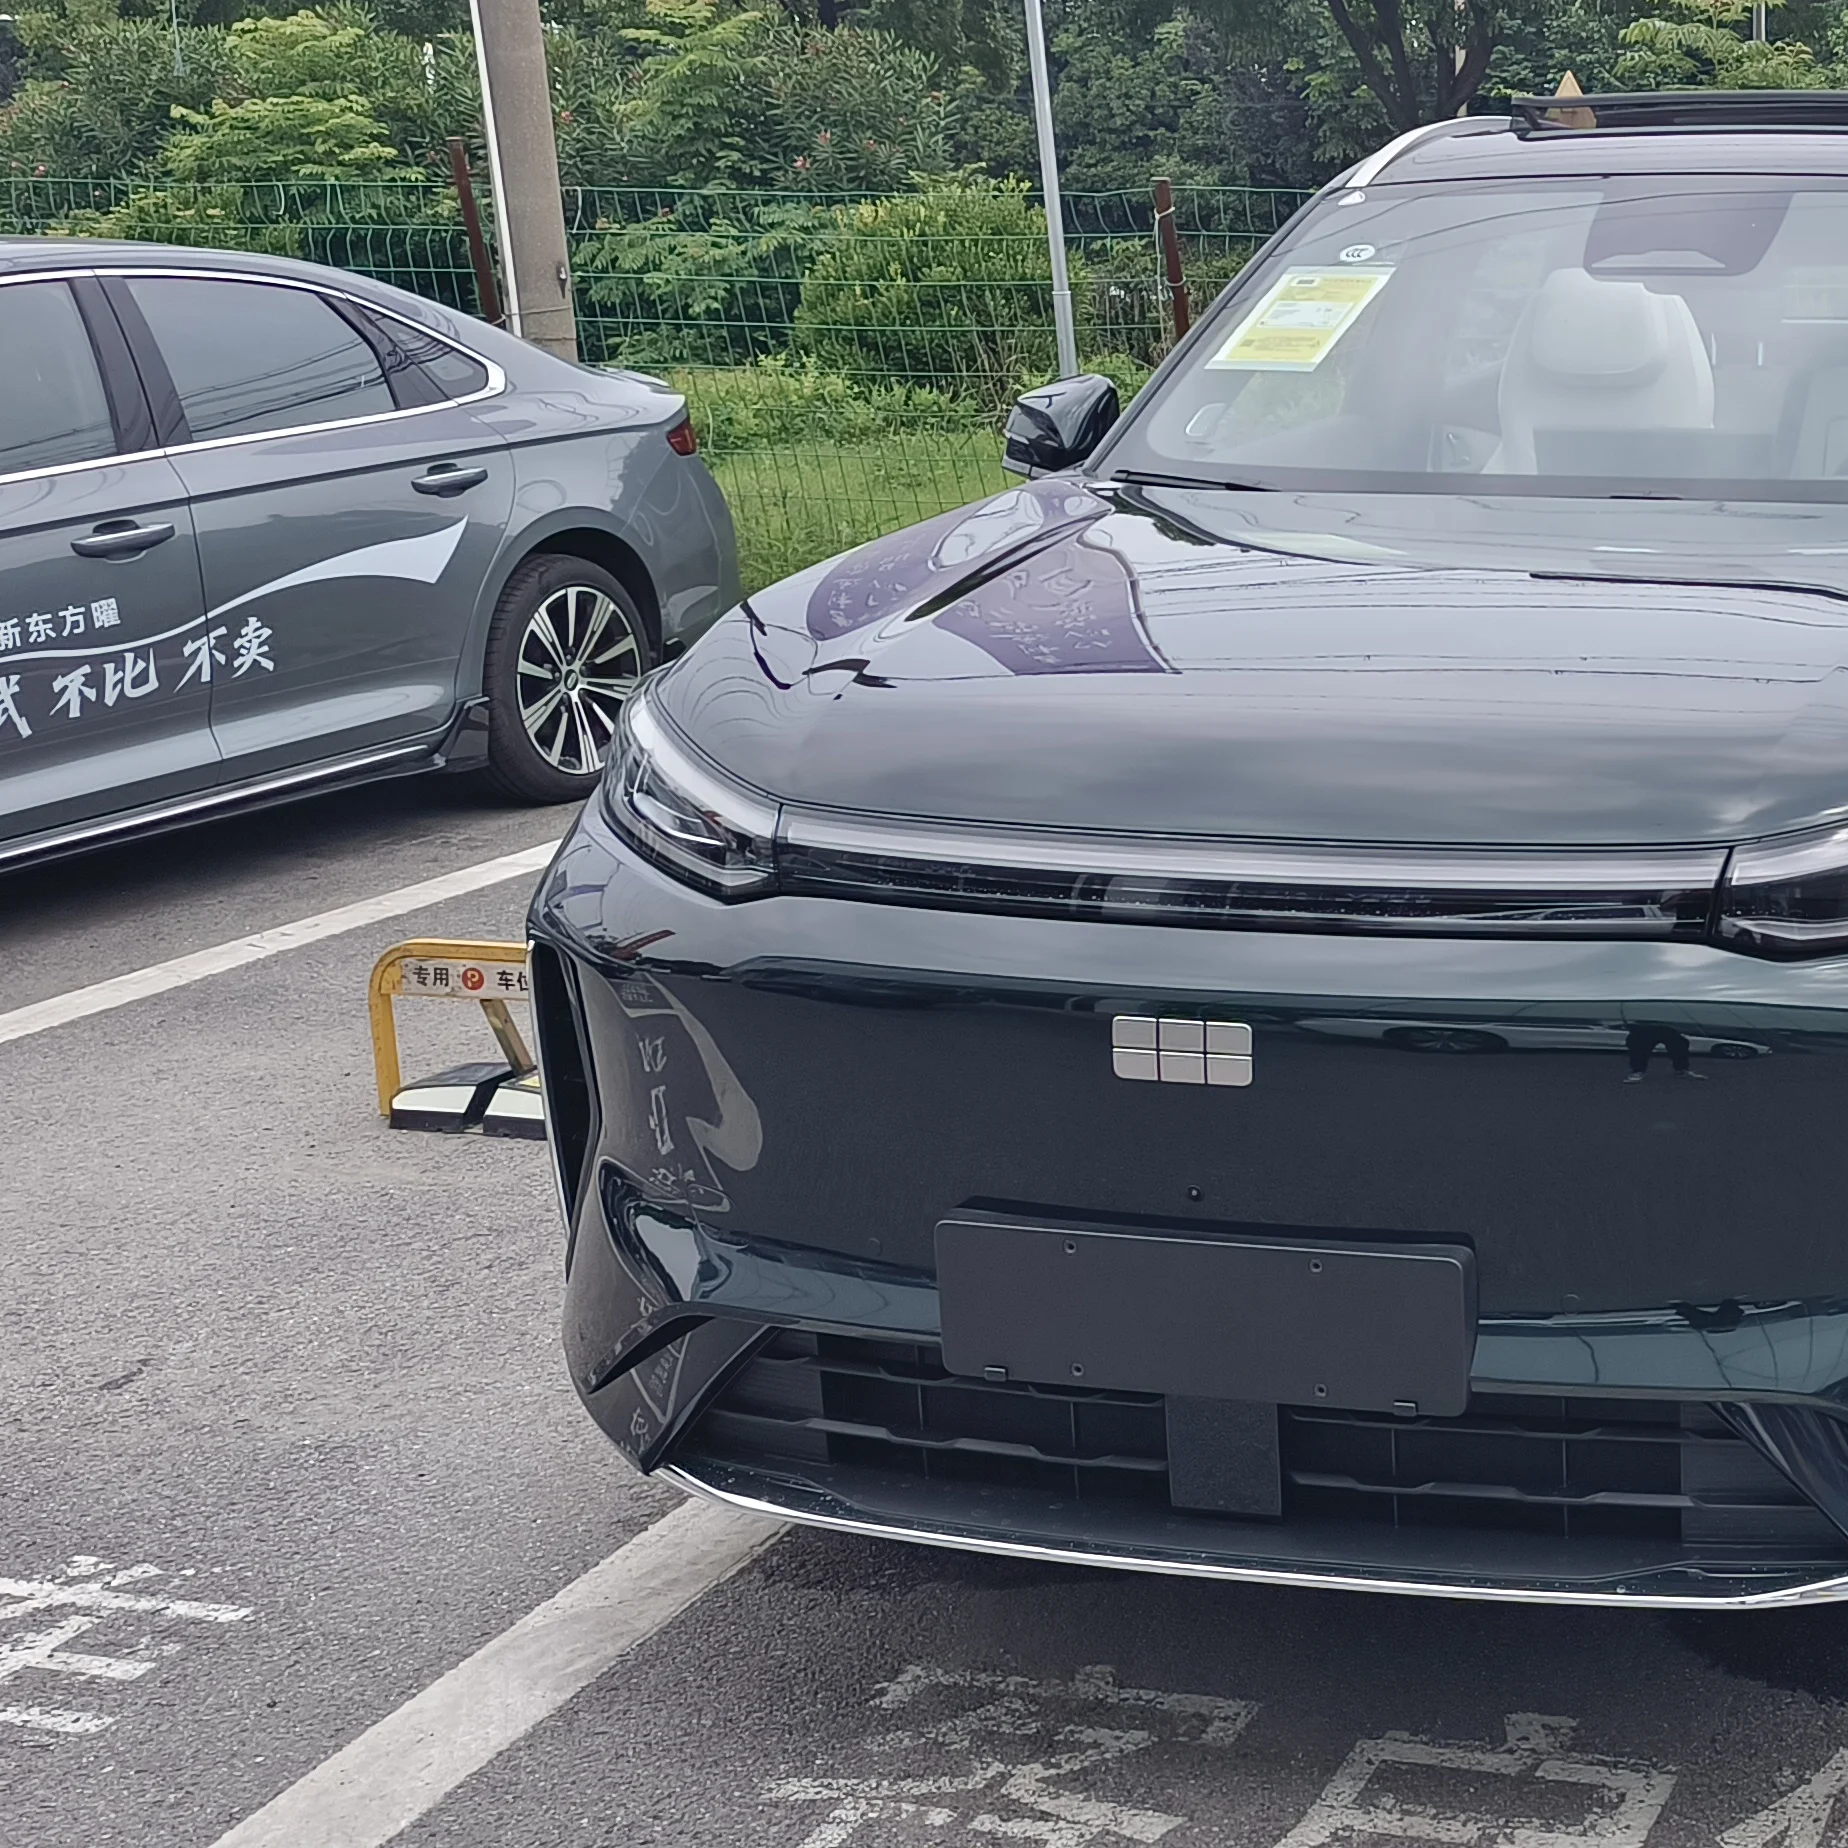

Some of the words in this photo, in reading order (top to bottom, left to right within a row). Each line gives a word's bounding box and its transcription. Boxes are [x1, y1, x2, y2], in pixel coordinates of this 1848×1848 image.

[50, 648, 158, 718] 不比
[174, 617, 275, 693] 不卖
[413, 965, 449, 987] 专用
